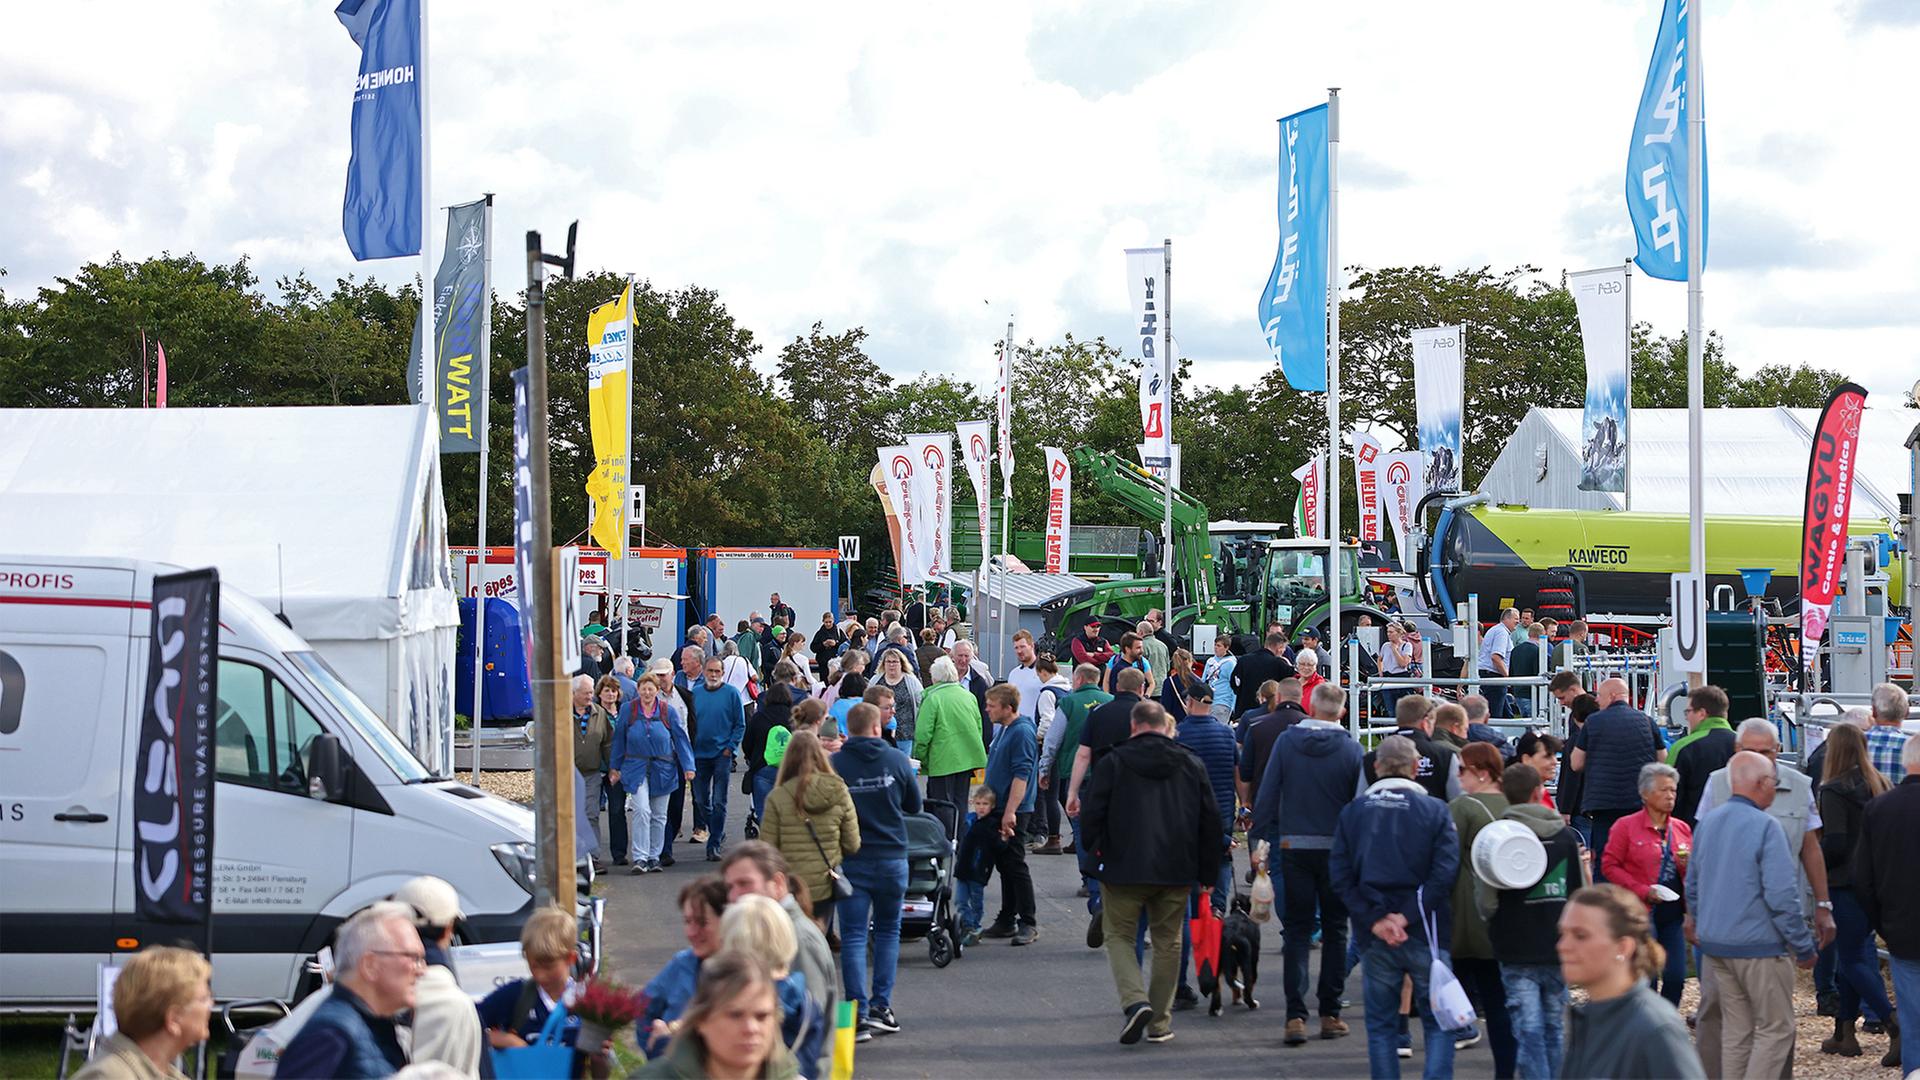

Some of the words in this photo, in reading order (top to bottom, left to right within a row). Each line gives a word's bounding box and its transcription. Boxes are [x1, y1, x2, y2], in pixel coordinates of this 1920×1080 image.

[842, 538, 857, 558] W
[1806, 431, 1837, 590] WAGYU
[1822, 538, 1838, 596] Cattle
[1834, 440, 1850, 518] Genetics
[1568, 549, 1628, 564] KAWECO
[1675, 580, 1698, 661] U
[195, 703, 208, 777] WATER
[193, 788, 207, 904] PRESSURE
